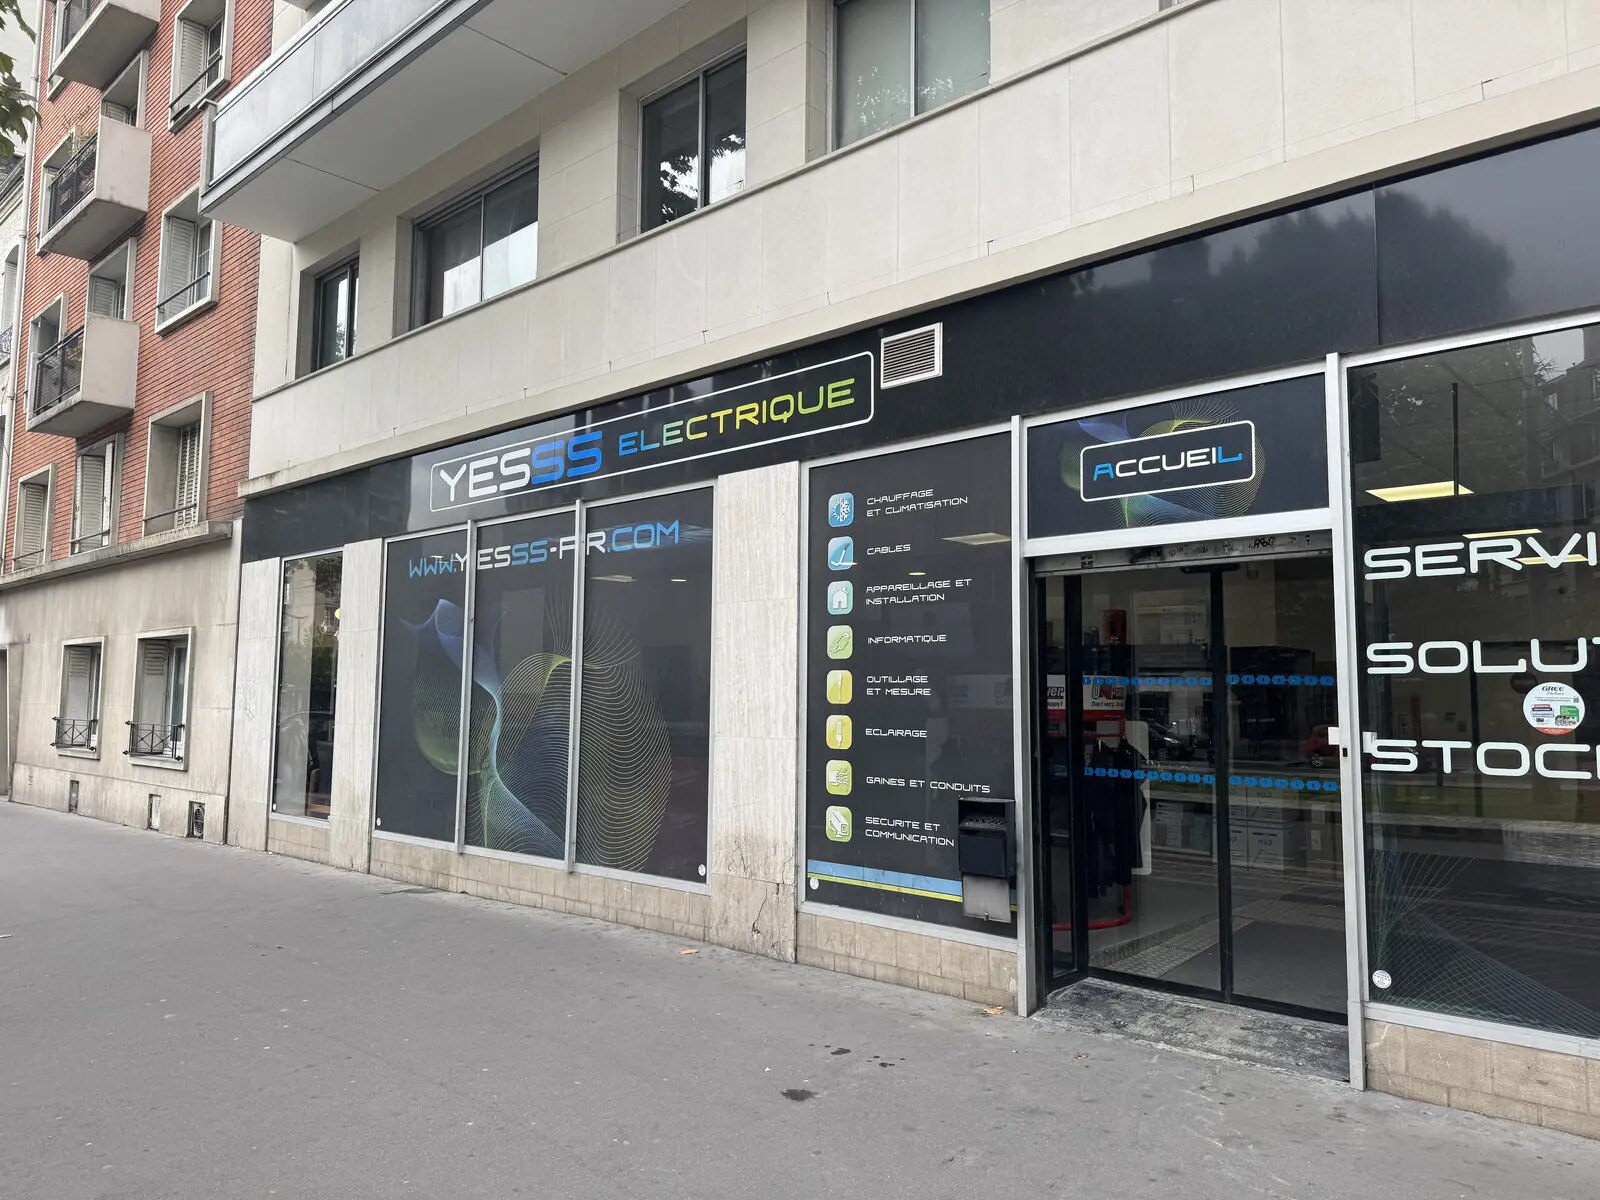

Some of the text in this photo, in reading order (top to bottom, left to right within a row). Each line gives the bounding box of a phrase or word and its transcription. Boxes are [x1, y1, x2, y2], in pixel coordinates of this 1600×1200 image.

[440, 378, 855, 502] YESSS ELECTRIQUE
[1093, 446, 1242, 481] ACCUEIL
[866, 489, 934, 505] CHAUFFAGE
[866, 497, 968, 517] ET CLIMATISATION
[866, 544, 911, 555] CABLES
[1364, 532, 1598, 581] SERVI
[865, 578, 972, 593] APPAREILLAGE ET
[865, 594, 945, 606] INSTALLATION
[867, 634, 947, 645] INFORMATIQUE
[1366, 637, 1600, 675] SOLU
[866, 675, 929, 683] OUTILLAGE
[866, 688, 931, 696] ET MESURE
[865, 728, 927, 738] ECLAIRAGE
[1371, 739, 1600, 780] STOC
[866, 776, 990, 793] GAINES ET CONDUITS
[865, 816, 940, 832] SECURITE ET
[865, 829, 955, 847] COMMUNICATION
